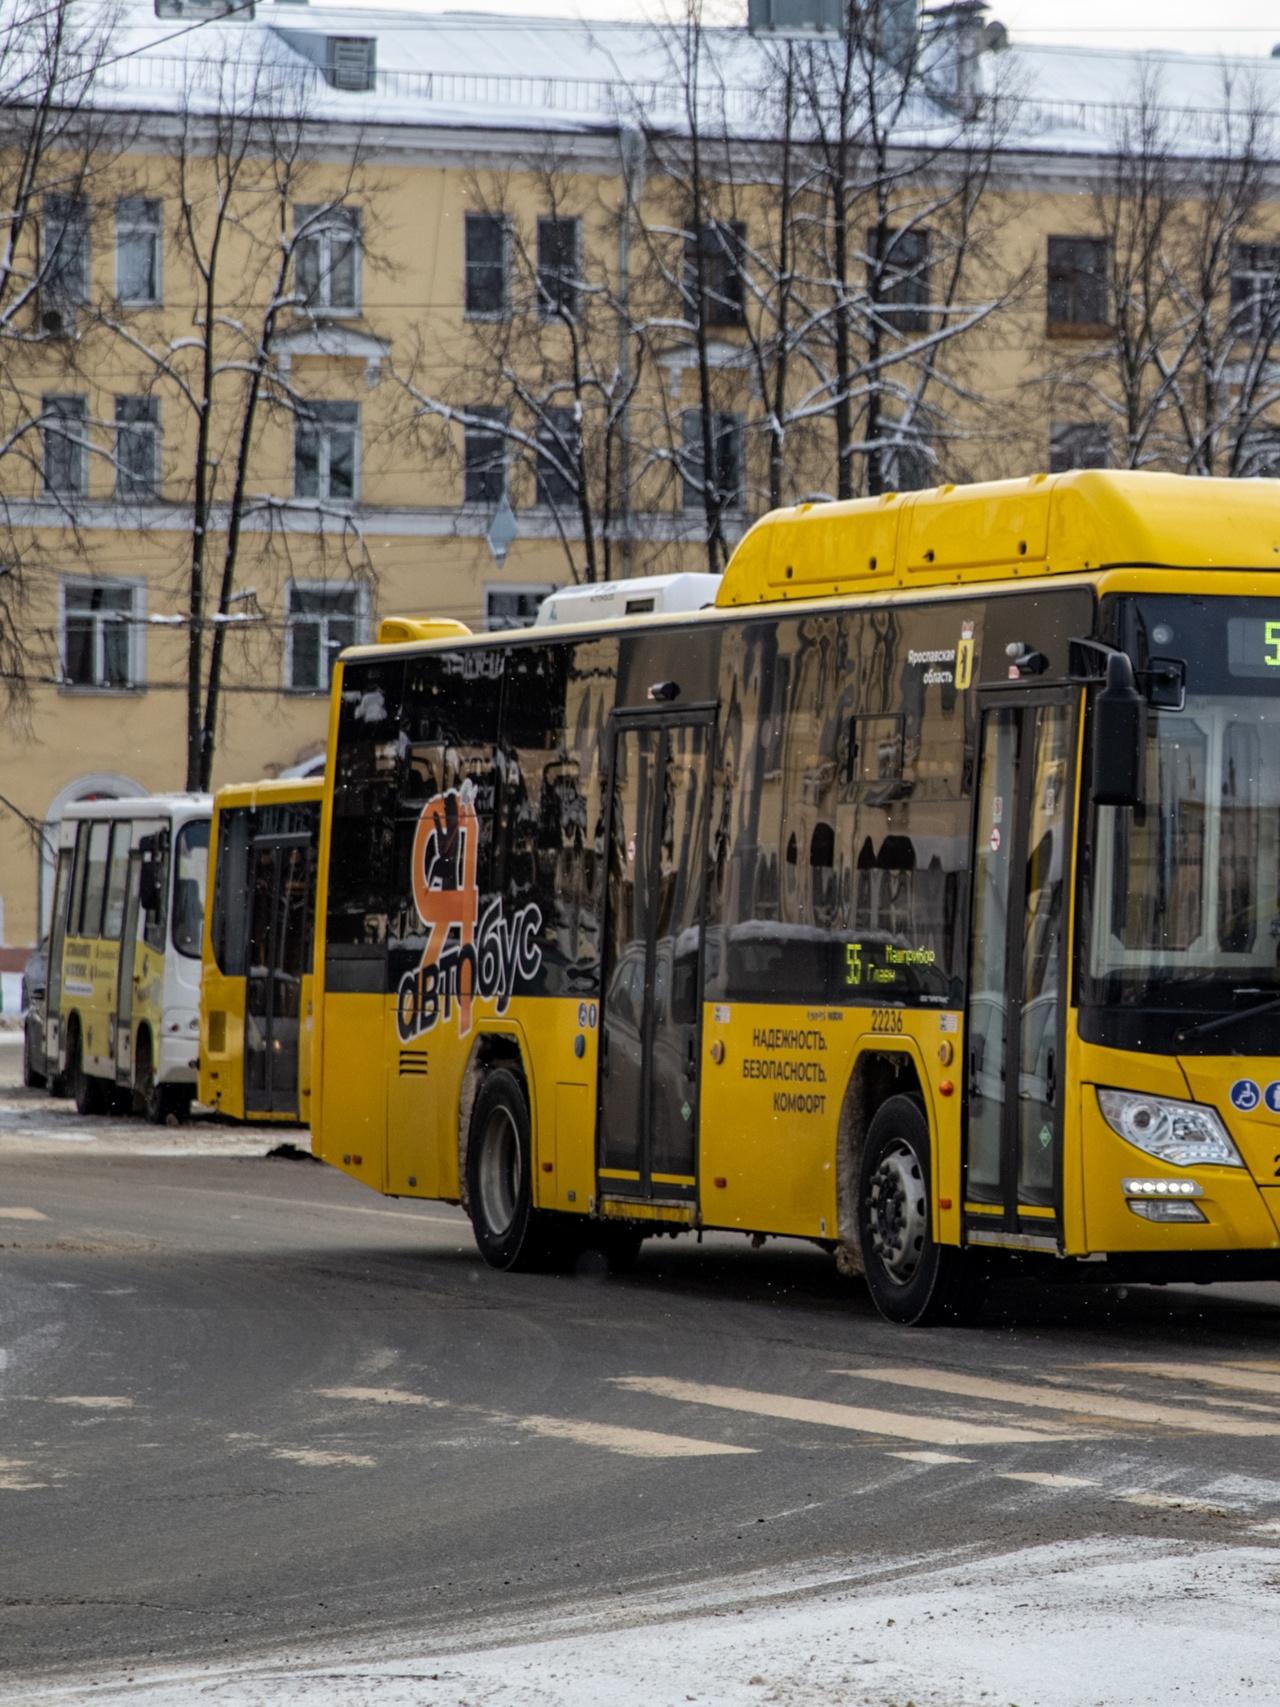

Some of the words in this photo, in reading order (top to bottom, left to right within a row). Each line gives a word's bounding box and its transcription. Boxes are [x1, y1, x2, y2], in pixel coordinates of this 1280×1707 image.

[908, 650, 955, 666] Ярославская
[923, 669, 953, 684] область
[396, 897, 542, 1043] автобус
[846, 943, 862, 985] 55
[871, 1009, 903, 1032] 22236
[773, 1092, 827, 1115] КОМФОРТ
